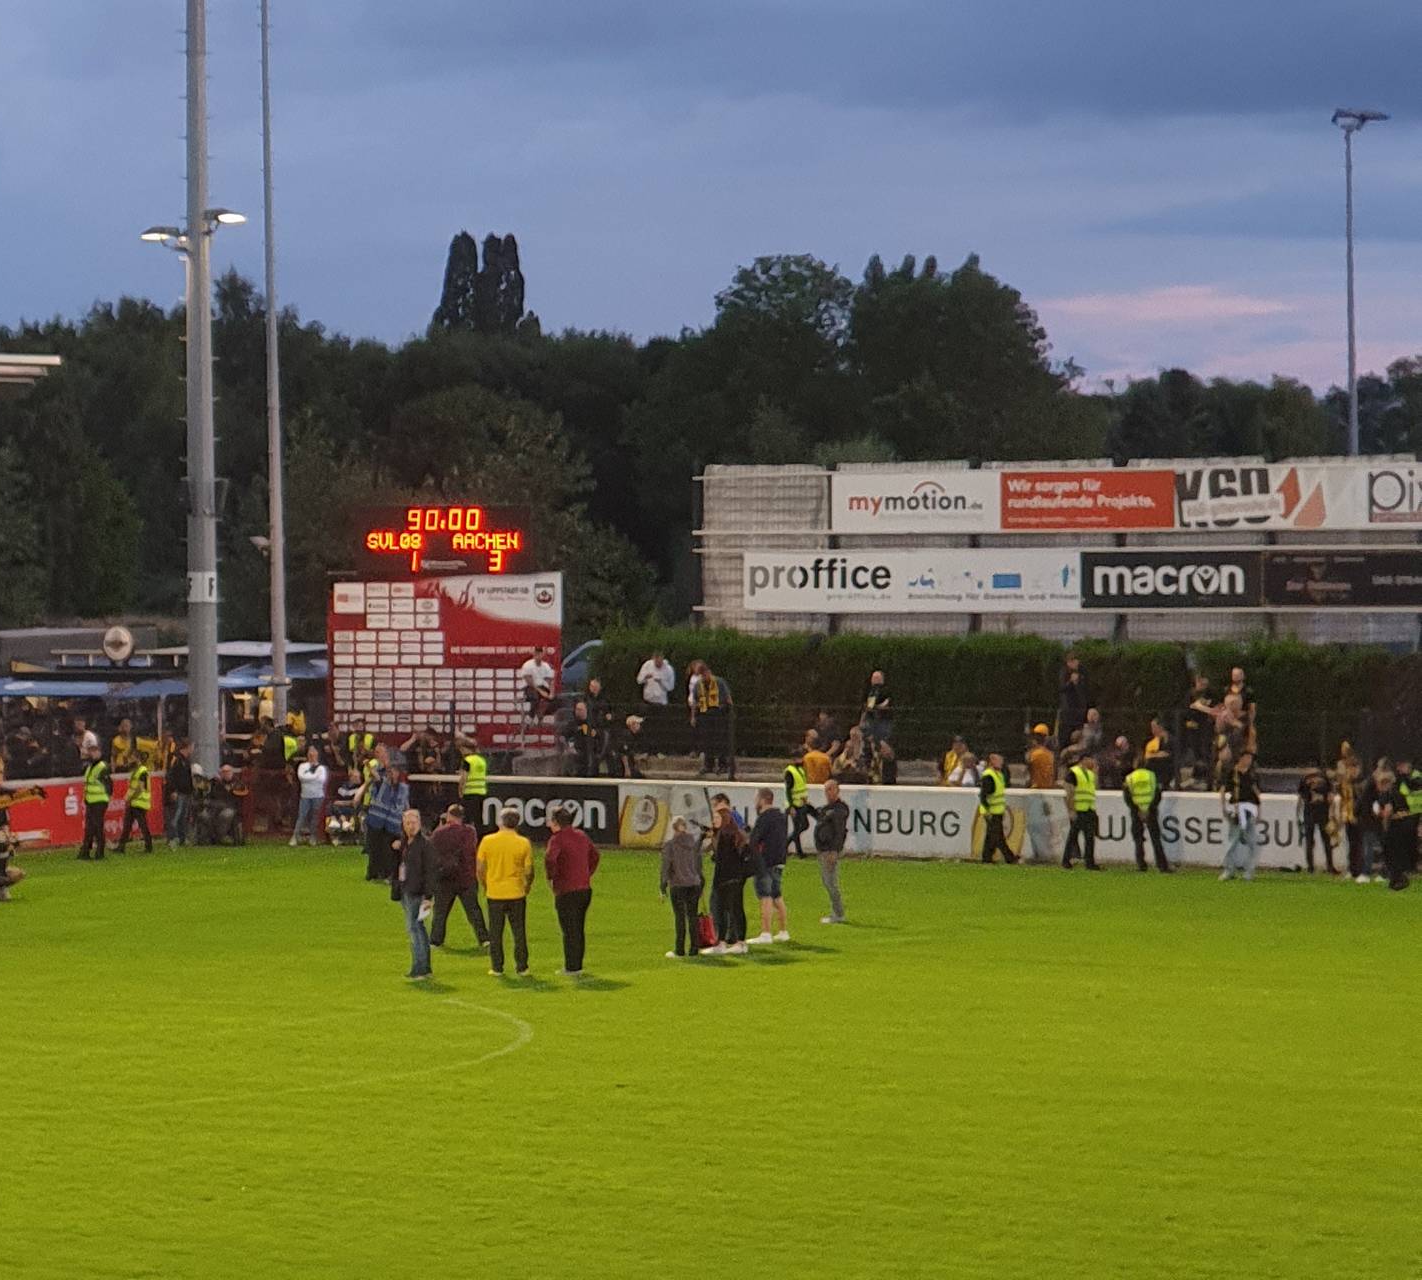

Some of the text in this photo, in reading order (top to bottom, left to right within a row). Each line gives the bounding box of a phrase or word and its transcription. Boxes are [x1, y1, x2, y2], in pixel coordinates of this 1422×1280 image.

[453, 533, 519, 550] AACHEN
[411, 551, 418, 572] 1
[488, 551, 502, 572] 3
[749, 558, 891, 597] proffice
[1093, 565, 1245, 596] macron
